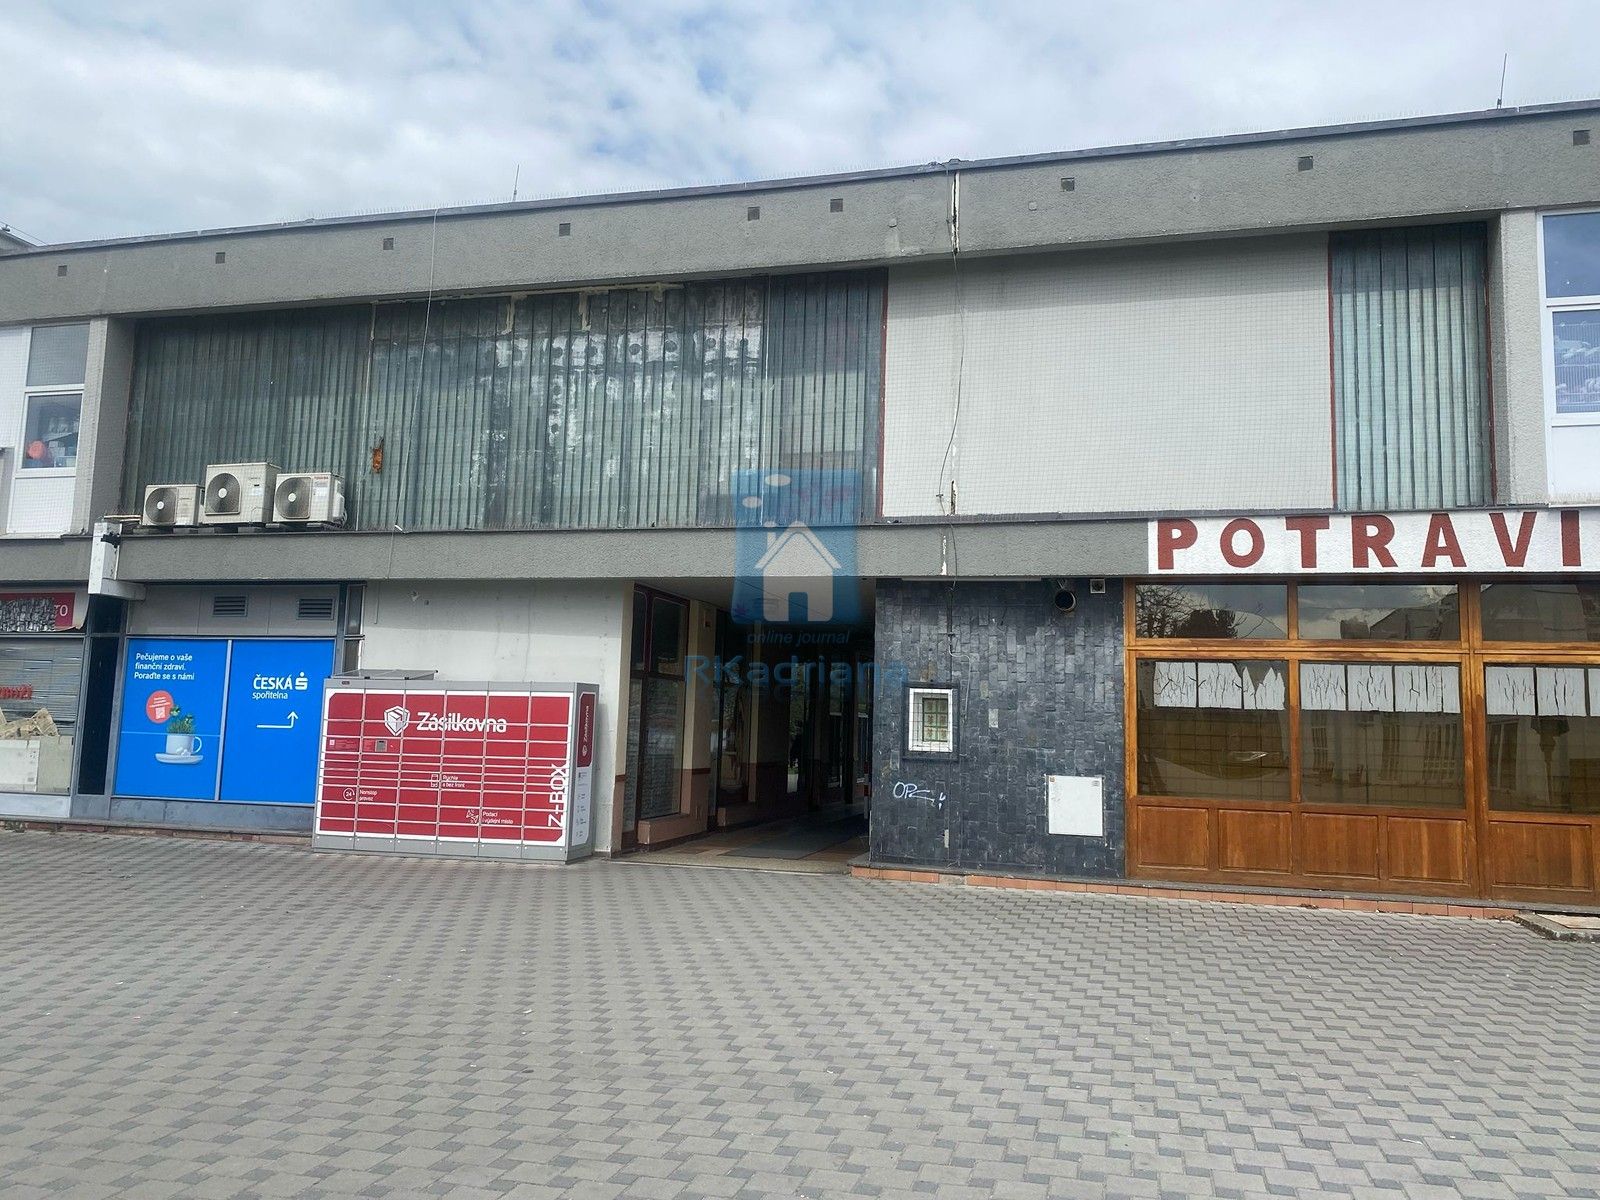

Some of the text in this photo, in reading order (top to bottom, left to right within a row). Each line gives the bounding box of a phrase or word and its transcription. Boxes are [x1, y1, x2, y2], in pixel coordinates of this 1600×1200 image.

[1157, 509, 1582, 570] POTRAVI
[135, 652, 169, 662] Pečujeme
[176, 653, 193, 661] vaše
[134, 662, 163, 670] finanční
[133, 671, 161, 680] Poraďte
[177, 673, 195, 681] námi
[253, 673, 293, 690] ČESKÁ
[252, 690, 289, 701] spořitelna
[416, 711, 507, 733] Zásilkovna
[548, 763, 569, 827] Z-BOX
